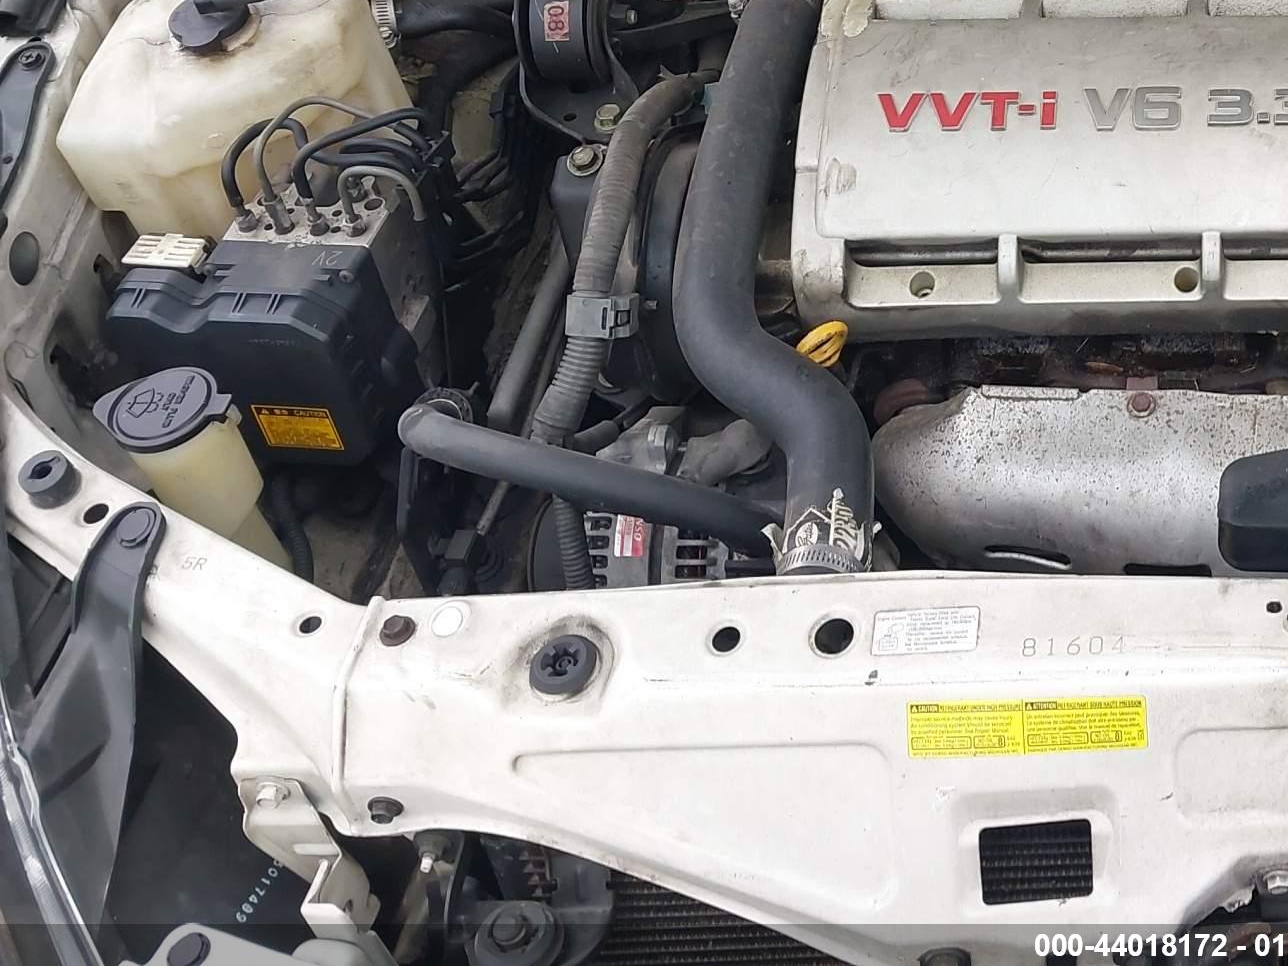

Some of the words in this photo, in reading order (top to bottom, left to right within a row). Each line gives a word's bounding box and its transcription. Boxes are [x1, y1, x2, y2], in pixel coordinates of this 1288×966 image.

[877, 89, 1058, 133] VVT-i
[1083, 85, 1183, 132] V6
[181, 556, 208, 571] 5R
[1022, 634, 1125, 657] 81604
[918, 705, 938, 713] CAUTION
